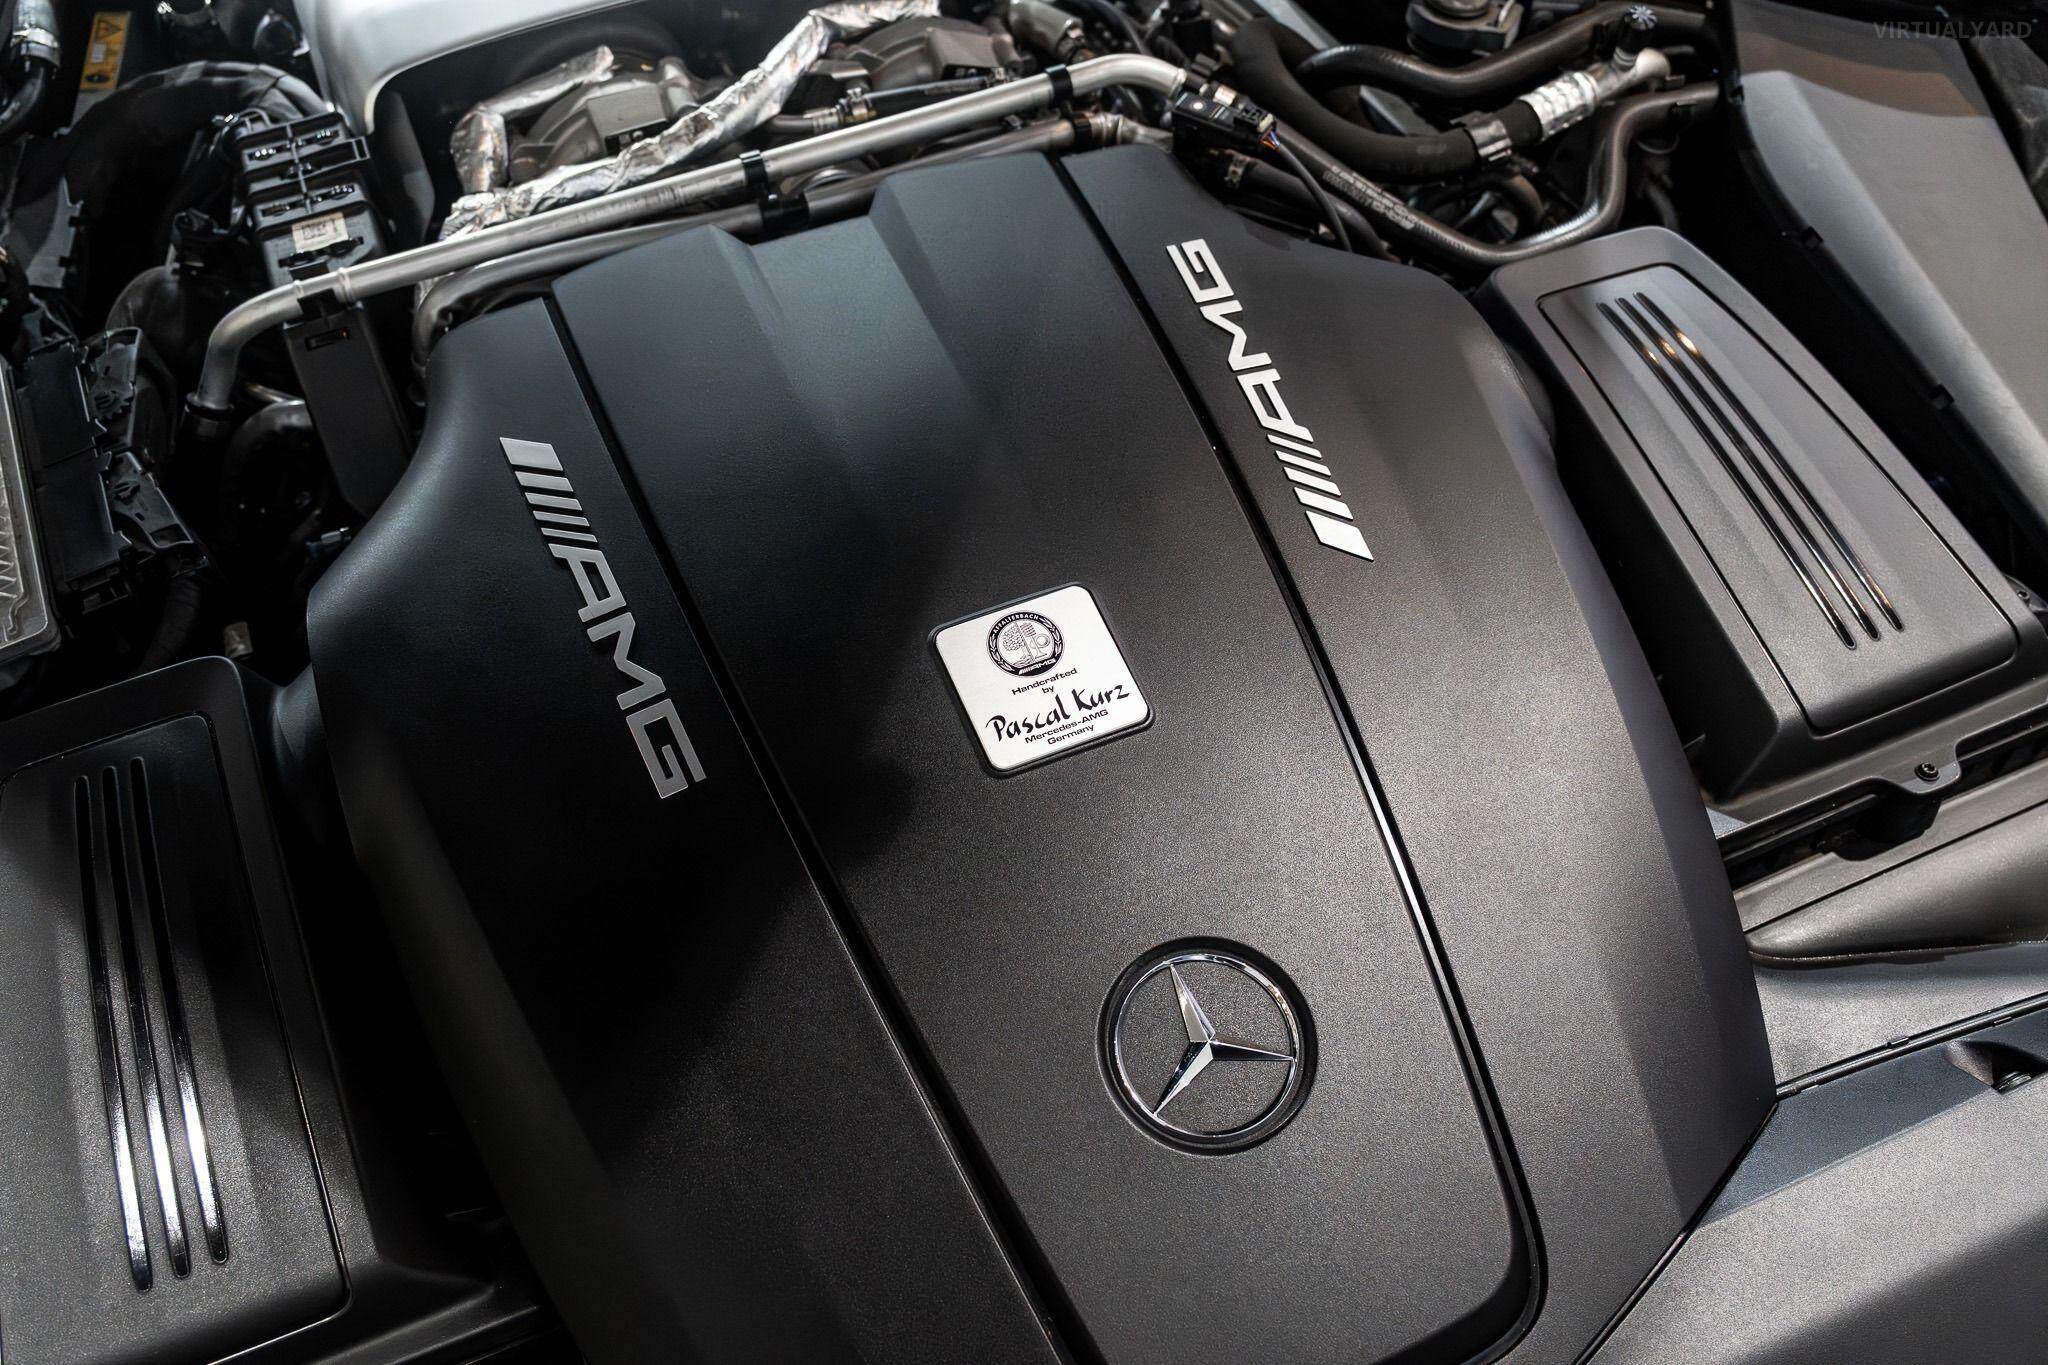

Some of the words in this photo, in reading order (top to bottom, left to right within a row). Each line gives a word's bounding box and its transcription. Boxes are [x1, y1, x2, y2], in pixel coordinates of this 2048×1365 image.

[1164, 238, 1312, 443] AMG
[547, 541, 707, 799] AMG
[1011, 668, 1078, 695] Handcrafted
[1041, 685, 1055, 694] by
[985, 696, 1071, 742] Pascal
[1071, 684, 1130, 711] Kurz
[1025, 709, 1109, 744] Mercedes-AMG
[1047, 724, 1096, 745] Germany
